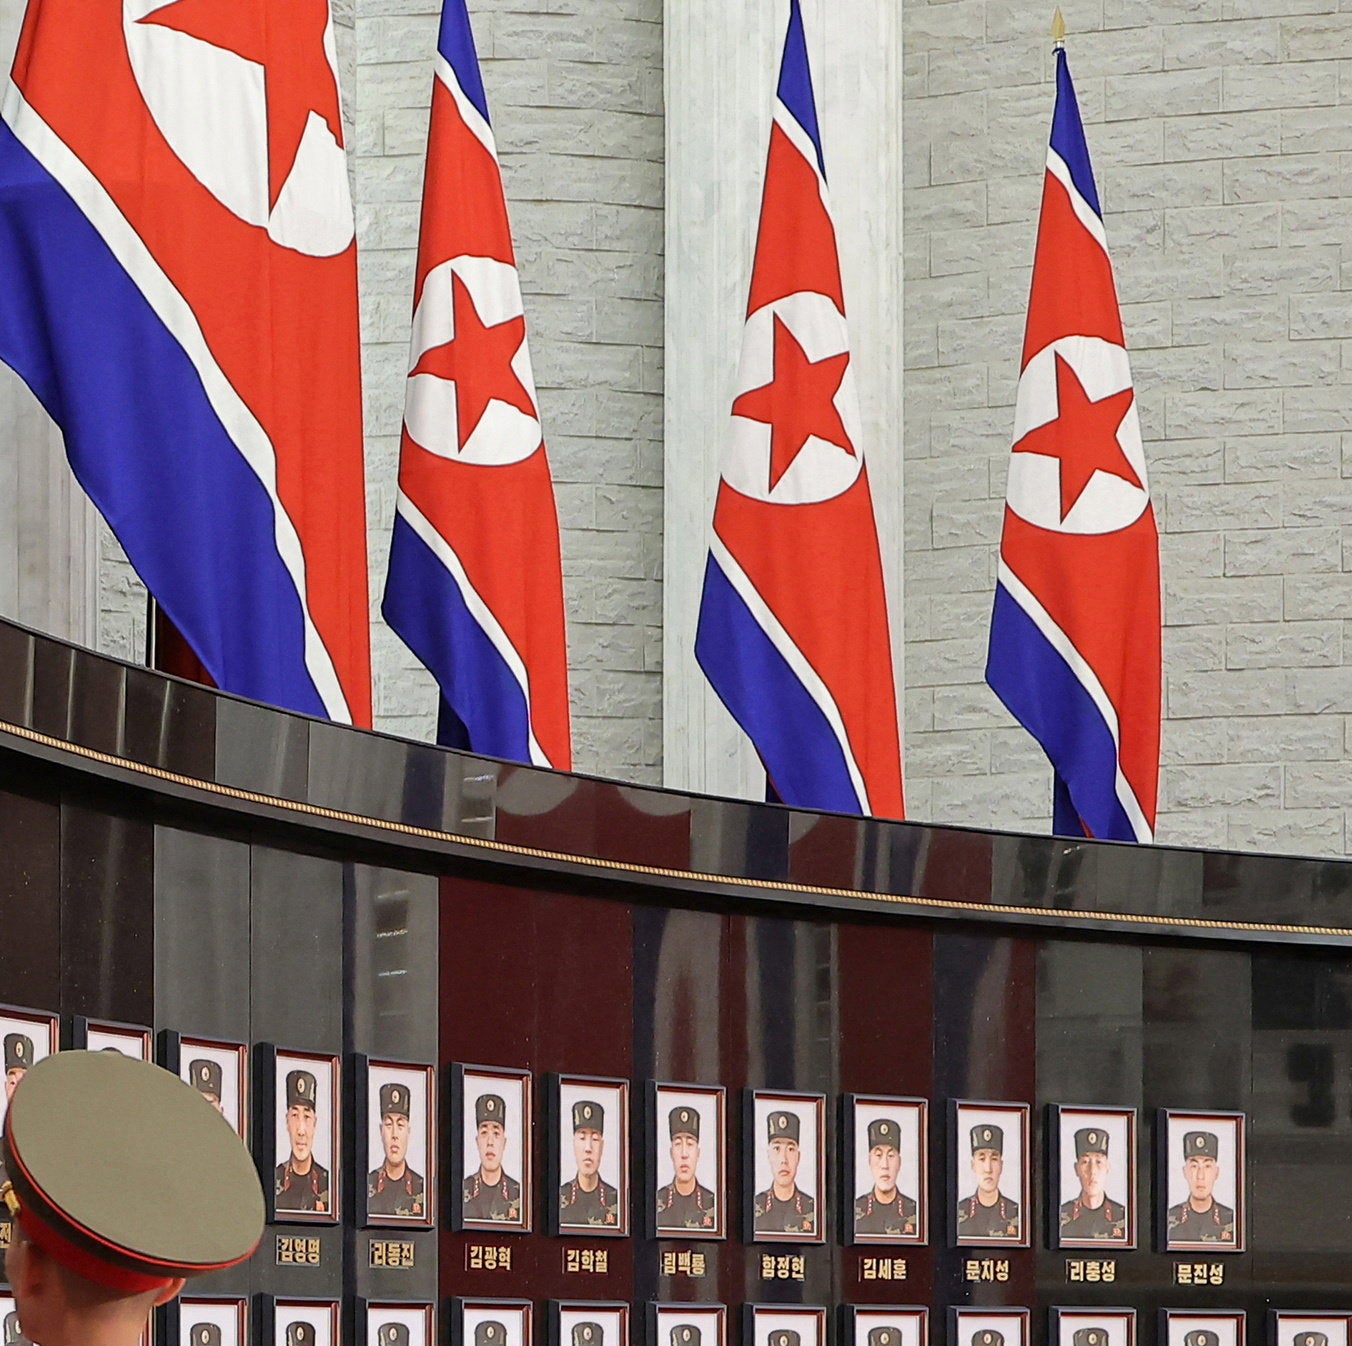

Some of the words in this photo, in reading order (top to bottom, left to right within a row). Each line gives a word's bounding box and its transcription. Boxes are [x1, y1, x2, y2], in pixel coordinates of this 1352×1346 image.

[470, 1245, 511, 1271] 김광혁
[567, 1249, 608, 1273] 김학철
[863, 1258, 906, 1280] 김세훈
[966, 1260, 1009, 1281] 문지성
[1178, 1263, 1222, 1284] 문진성
